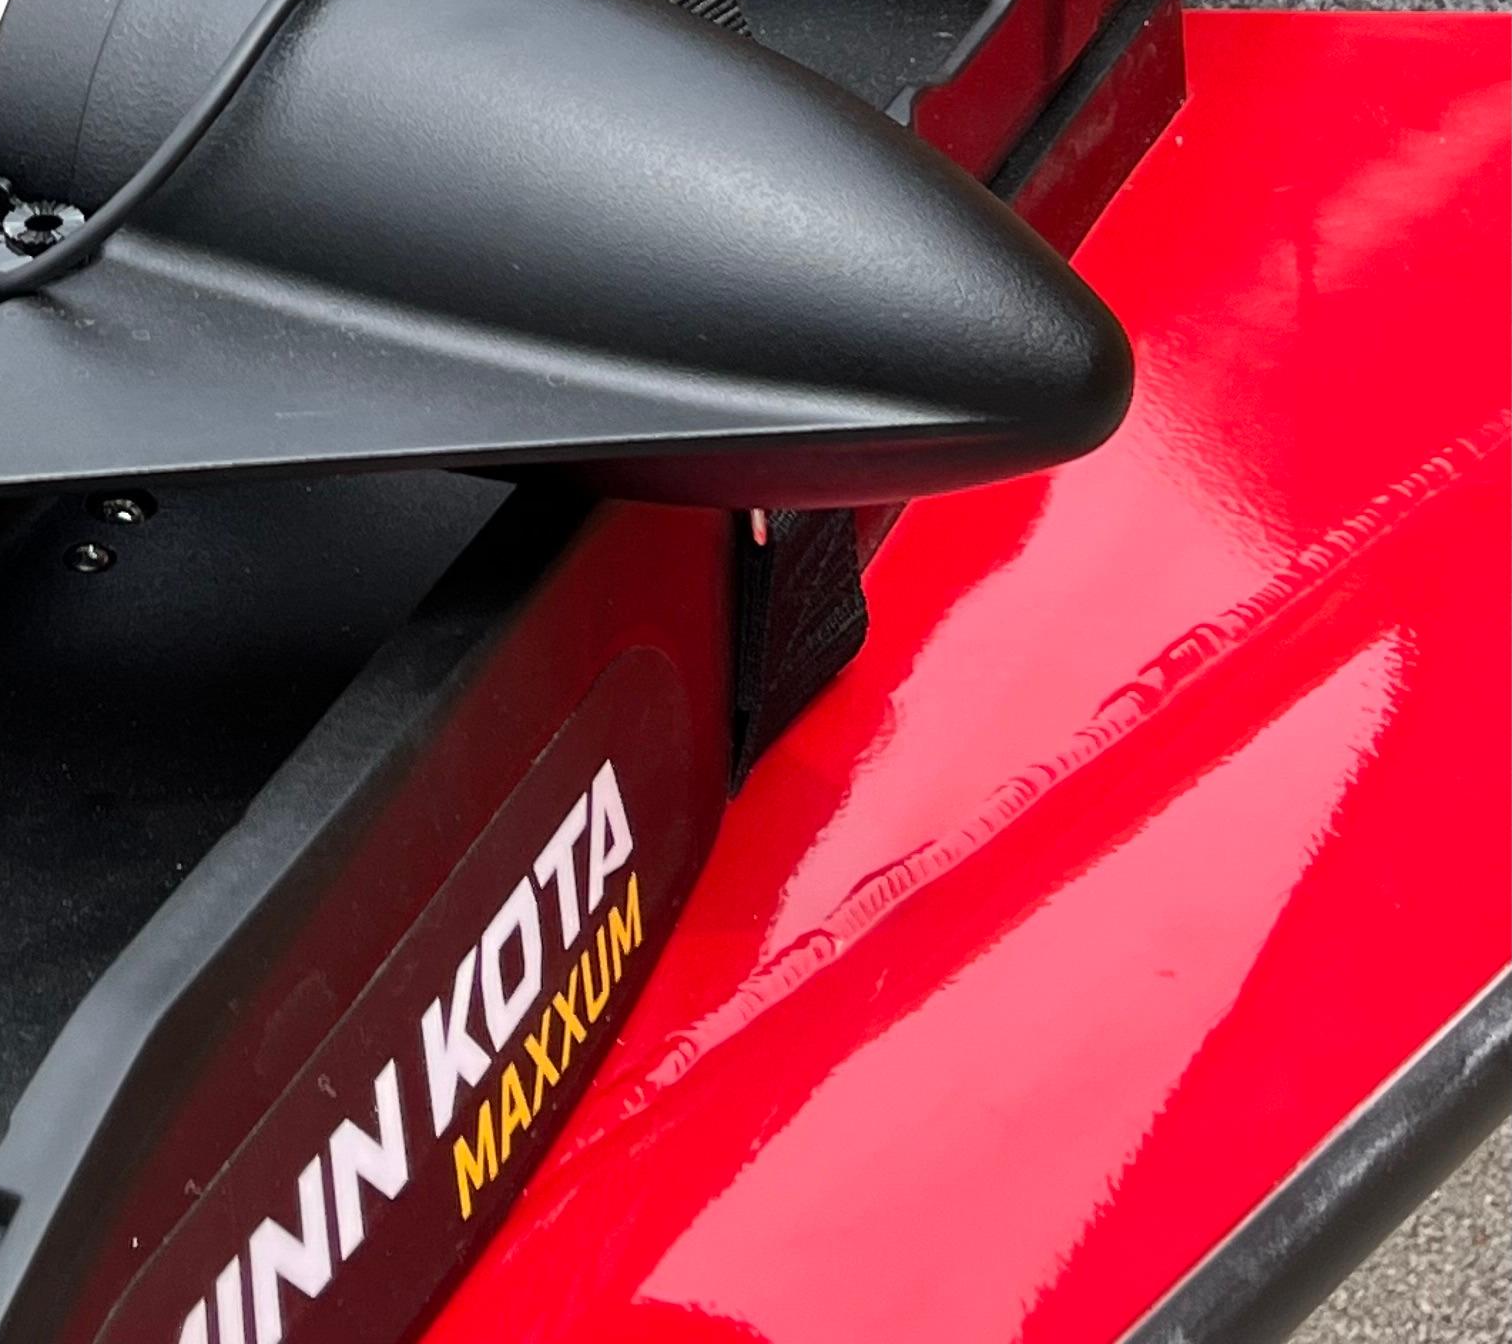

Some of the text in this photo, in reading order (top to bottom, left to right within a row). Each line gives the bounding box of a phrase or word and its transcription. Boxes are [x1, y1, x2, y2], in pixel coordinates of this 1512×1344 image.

[178, 759, 634, 1344] INN KOTA
[453, 872, 643, 1221] MAXXUM
